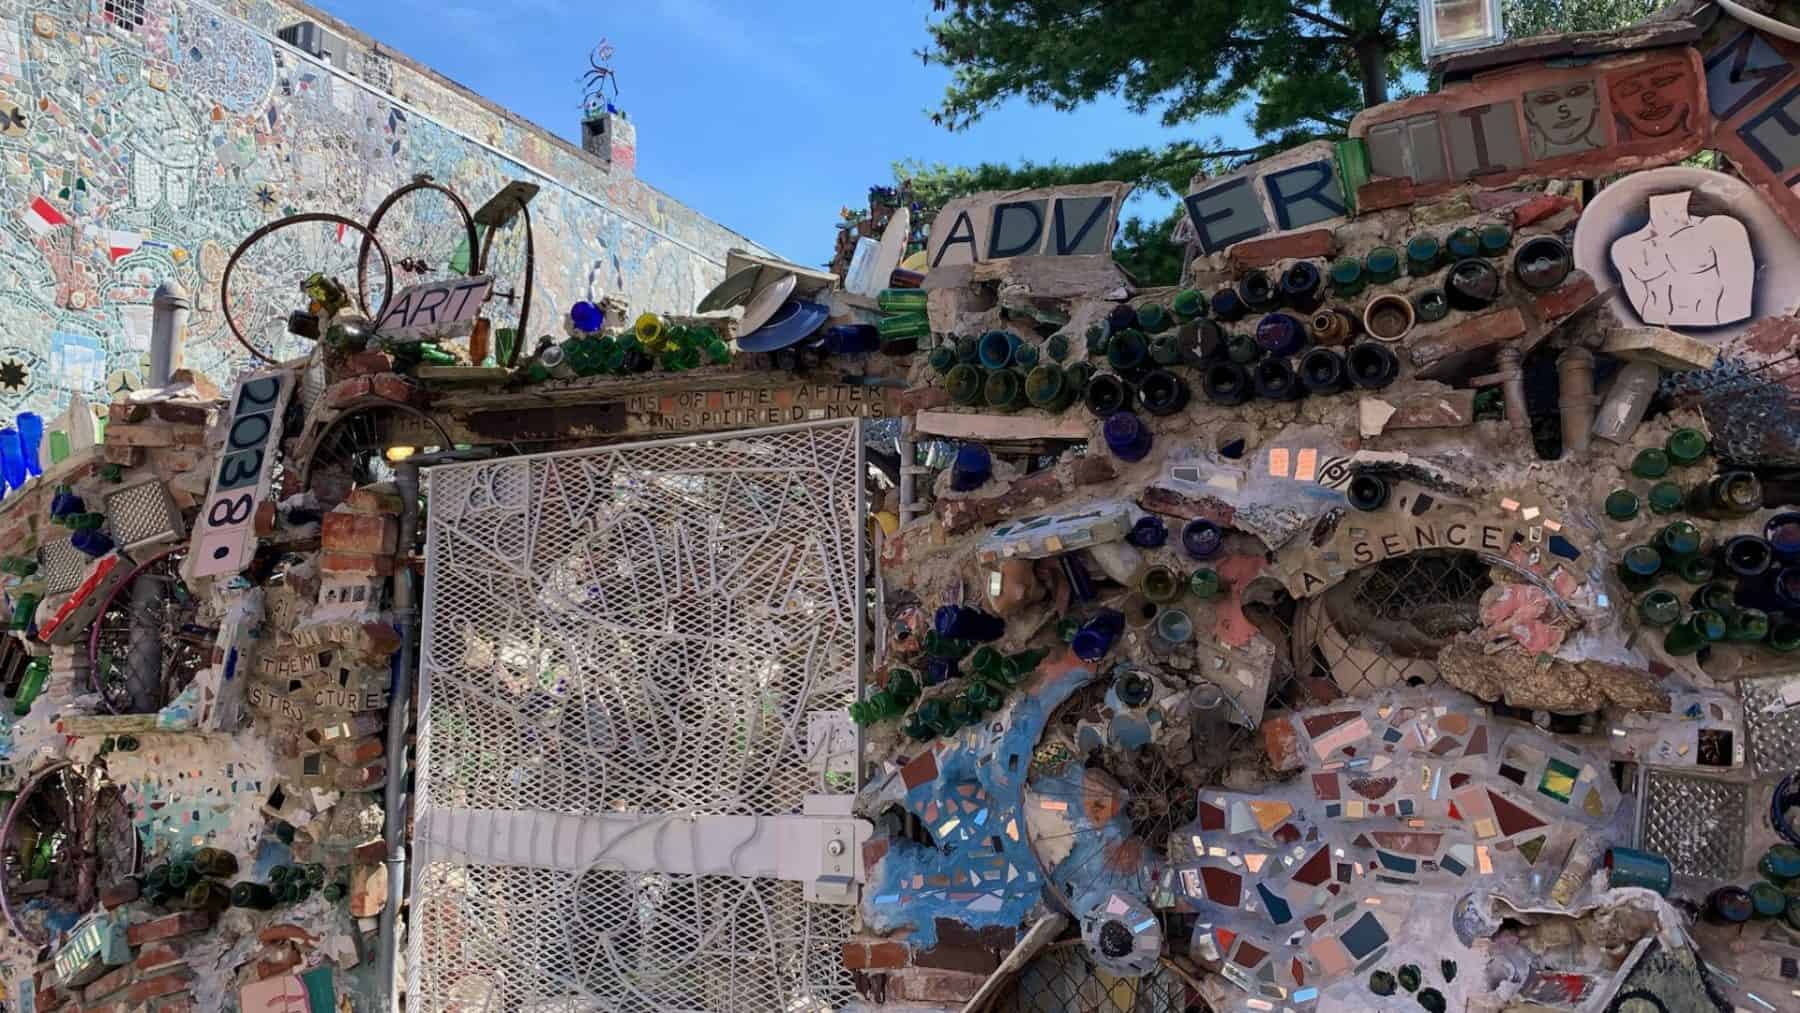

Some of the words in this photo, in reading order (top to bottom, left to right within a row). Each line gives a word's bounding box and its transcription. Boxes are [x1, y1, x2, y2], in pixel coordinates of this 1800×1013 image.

[378, 281, 489, 328] ART
[679, 392, 705, 409] OF
[725, 389, 768, 406] THE
[798, 385, 881, 401] AFTER
[1353, 523, 1503, 564] SENCE
